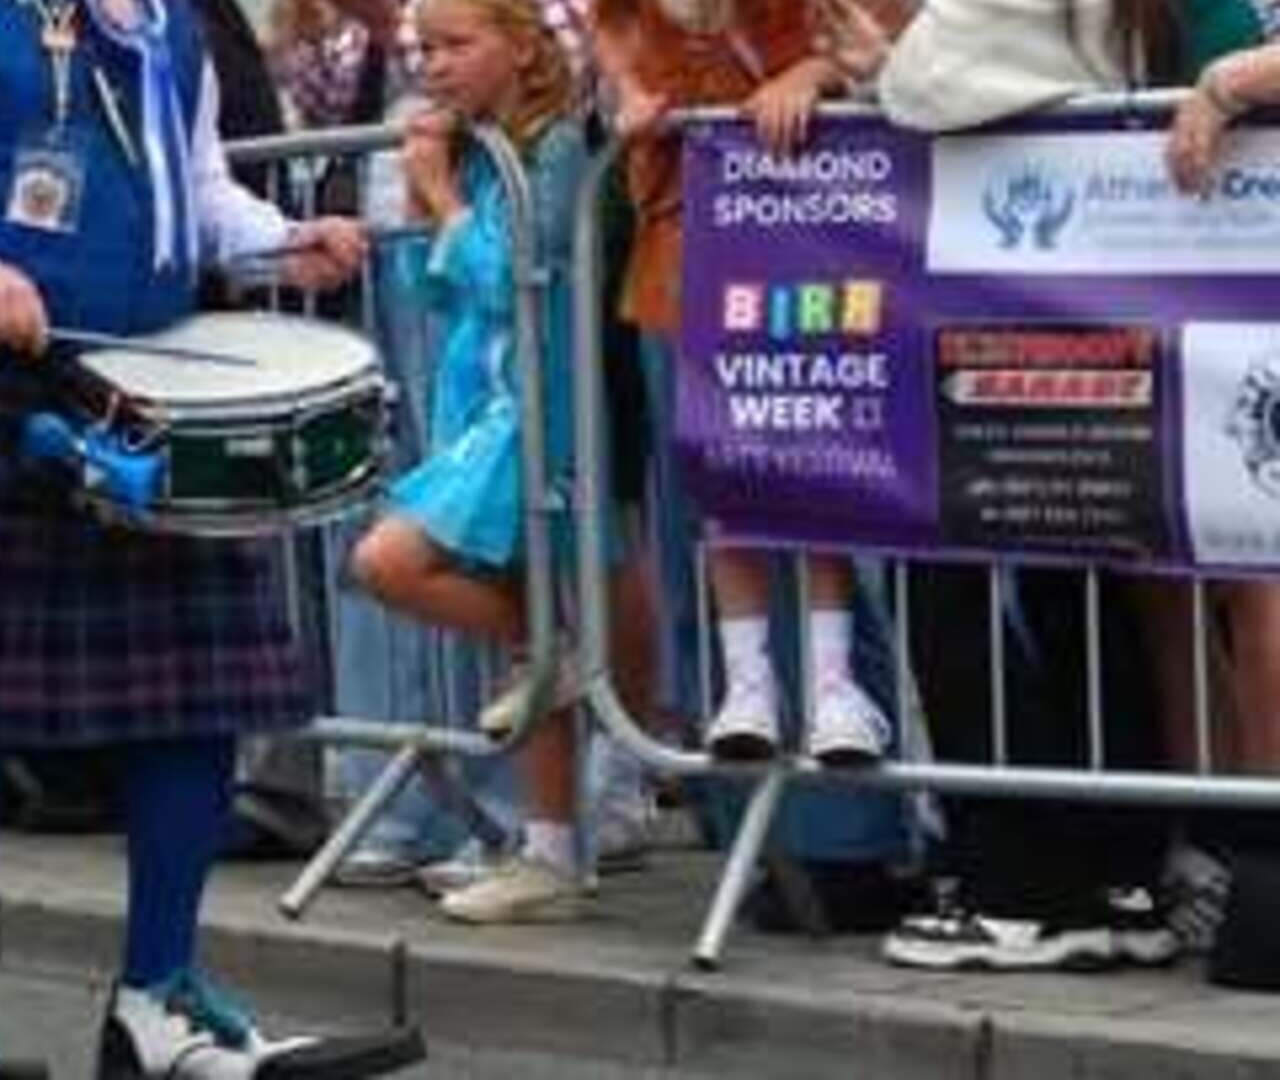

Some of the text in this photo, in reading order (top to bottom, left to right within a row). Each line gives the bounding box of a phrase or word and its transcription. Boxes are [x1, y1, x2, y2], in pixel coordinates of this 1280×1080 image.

[724, 151, 892, 181] DIAMOND
[714, 193, 897, 225] SPONSORS
[724, 281, 881, 340] BIRR
[715, 353, 889, 389] VINTAGE
[729, 394, 843, 429] WEEK
